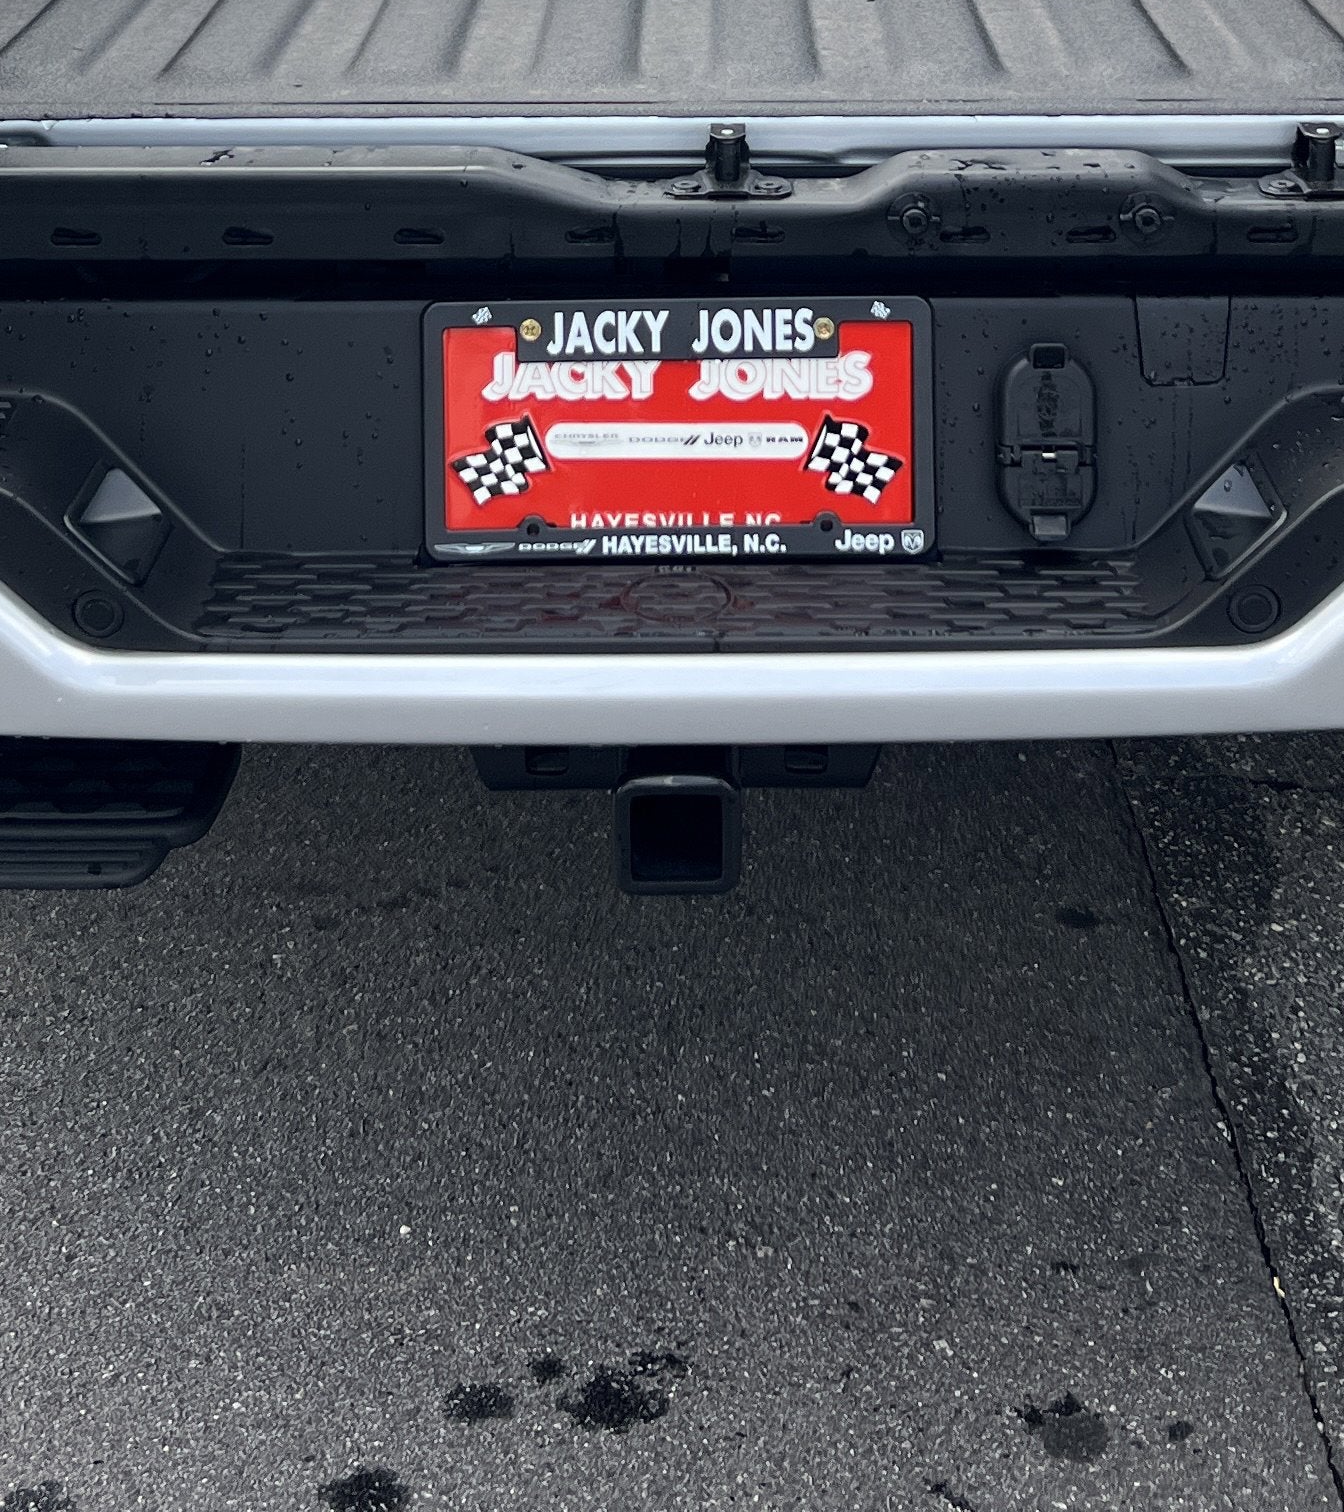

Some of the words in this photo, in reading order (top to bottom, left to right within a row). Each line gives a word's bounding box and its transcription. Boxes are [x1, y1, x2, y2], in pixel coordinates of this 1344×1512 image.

[546, 309, 669, 355] JACKY
[692, 307, 815, 354] JONES
[481, 351, 662, 402] JACKY
[688, 350, 874, 402] JONES
[703, 432, 743, 448] Jeep
[602, 534, 738, 556] HAYESVILLE,
[743, 533, 787, 554] N.C.
[835, 528, 895, 555] Jeep
